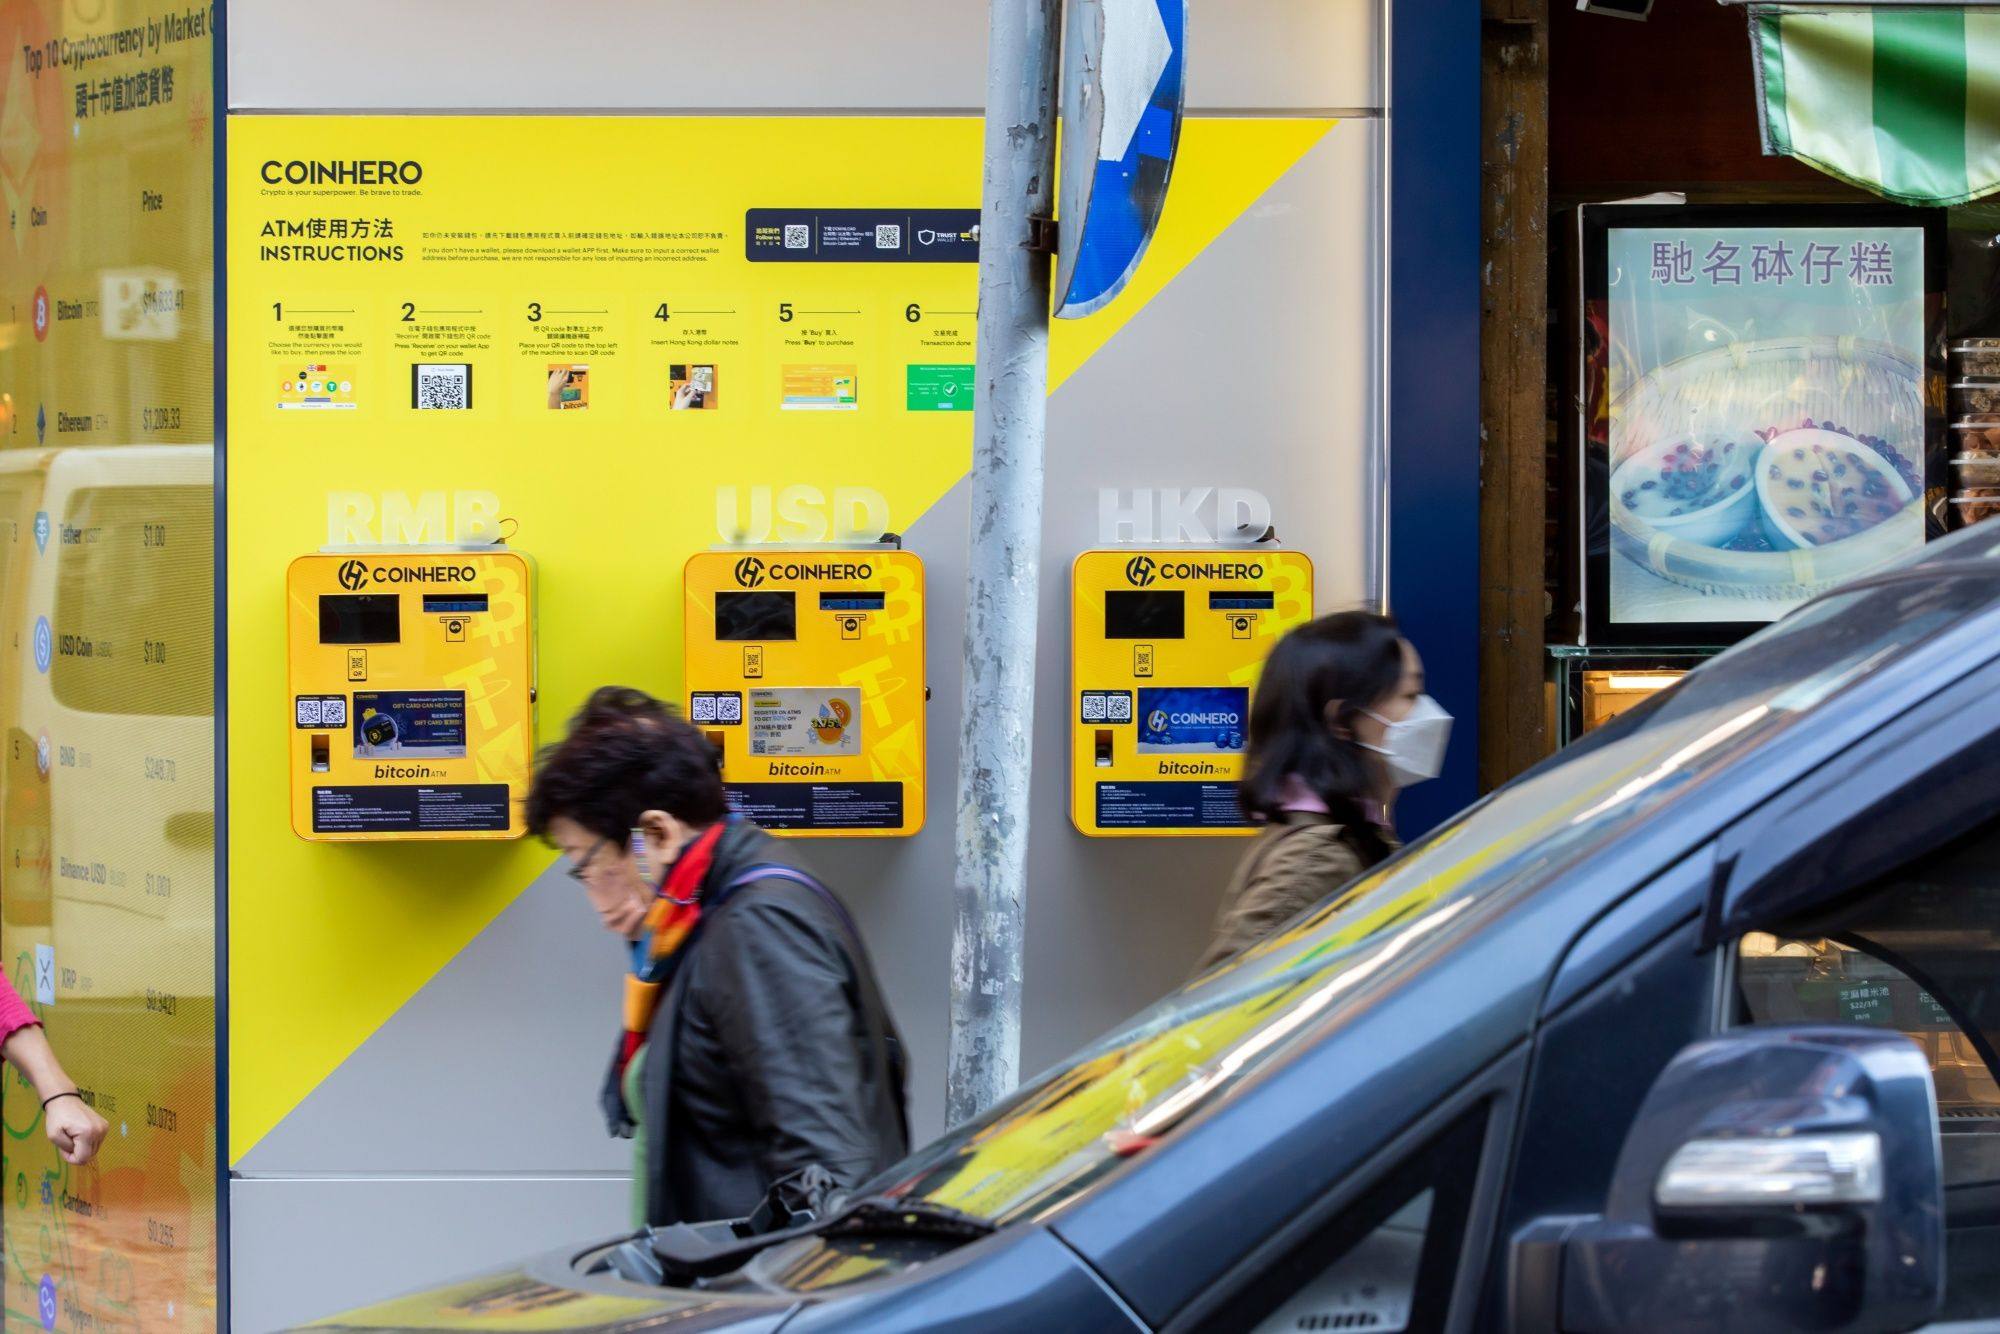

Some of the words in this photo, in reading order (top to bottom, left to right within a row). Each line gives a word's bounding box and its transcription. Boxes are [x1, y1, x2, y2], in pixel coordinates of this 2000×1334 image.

[24, 45, 42, 79] Top
[46, 40, 59, 68] 10
[61, 24, 145, 71] Cryptocurrency
[148, 17, 161, 54] by
[164, 7, 206, 45] Market
[75, 64, 174, 119] 頭十市值加密貨幣
[261, 160, 423, 185] COINHERO
[142, 190, 163, 212] Price
[261, 189, 286, 197] Crypto
[31, 207, 47, 227] Coin
[261, 218, 393, 239] ATM使用方法
[261, 245, 404, 262] INSTRUCTIONS
[503, 247, 524, 255] please
[654, 247, 670, 255] input
[1650, 239, 1895, 287] 馳名砵仔糕
[57, 300, 83, 321] Bitcoin
[273, 302, 281, 322] 1
[401, 302, 416, 322] 2
[527, 302, 542, 322] 3
[654, 302, 670, 322] 4
[779, 303, 793, 323] 5
[905, 303, 921, 323] 6
[479, 343, 490, 351] App
[597, 342, 607, 350] top
[651, 339, 668, 347] Insert
[670, 339, 686, 348] Hong
[687, 339, 703, 348] Kong
[704, 339, 721, 347] dollar
[723, 339, 739, 347] notes
[827, 339, 854, 347] purchase
[428, 350, 438, 358] get
[564, 401, 587, 409] bitcoin
[58, 412, 92, 433] Ethereum
[327, 490, 500, 545] RMB
[716, 485, 888, 543] USD
[1100, 487, 1271, 543] HKD
[59, 524, 82, 544] Tether
[373, 566, 476, 583] COINHERO
[769, 564, 872, 580] COINHERO
[1160, 564, 1264, 580] COINHERO
[59, 634, 75, 656] USD
[76, 636, 93, 657] Coin
[1170, 712, 1239, 725] COINHERO
[374, 765, 430, 779] bitcoin
[769, 762, 824, 776] bitcoin
[1159, 761, 1213, 775] bitcoin
[63, 1188, 92, 1217] Cardano
